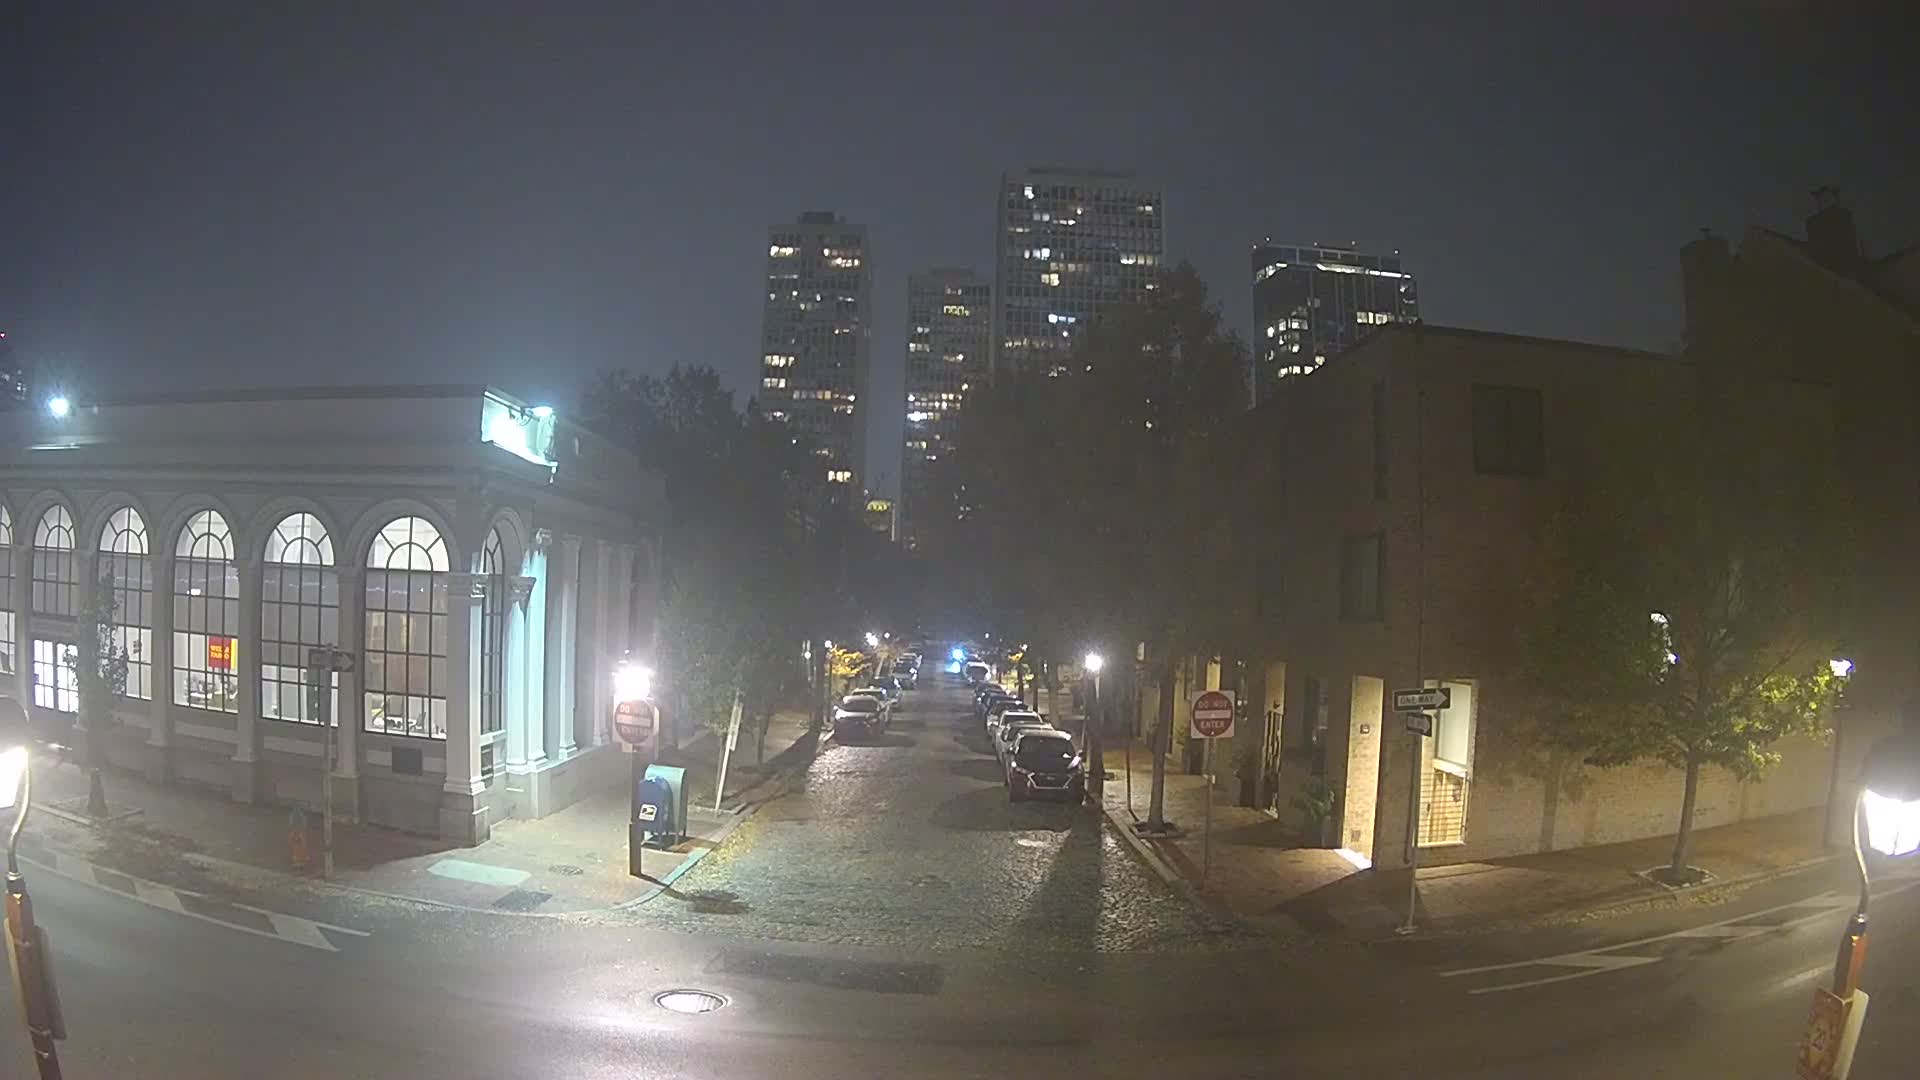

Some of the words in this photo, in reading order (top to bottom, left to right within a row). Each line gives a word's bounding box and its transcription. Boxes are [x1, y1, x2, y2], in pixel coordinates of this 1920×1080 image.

[210, 645, 229, 653] WELS
[210, 651, 229, 660] FARO
[1198, 700, 1209, 709] DO
[1400, 696, 1417, 705] ONE
[1418, 695, 1434, 704] WAY
[620, 704, 630, 713] DO
[1200, 720, 1225, 729] ENTER
